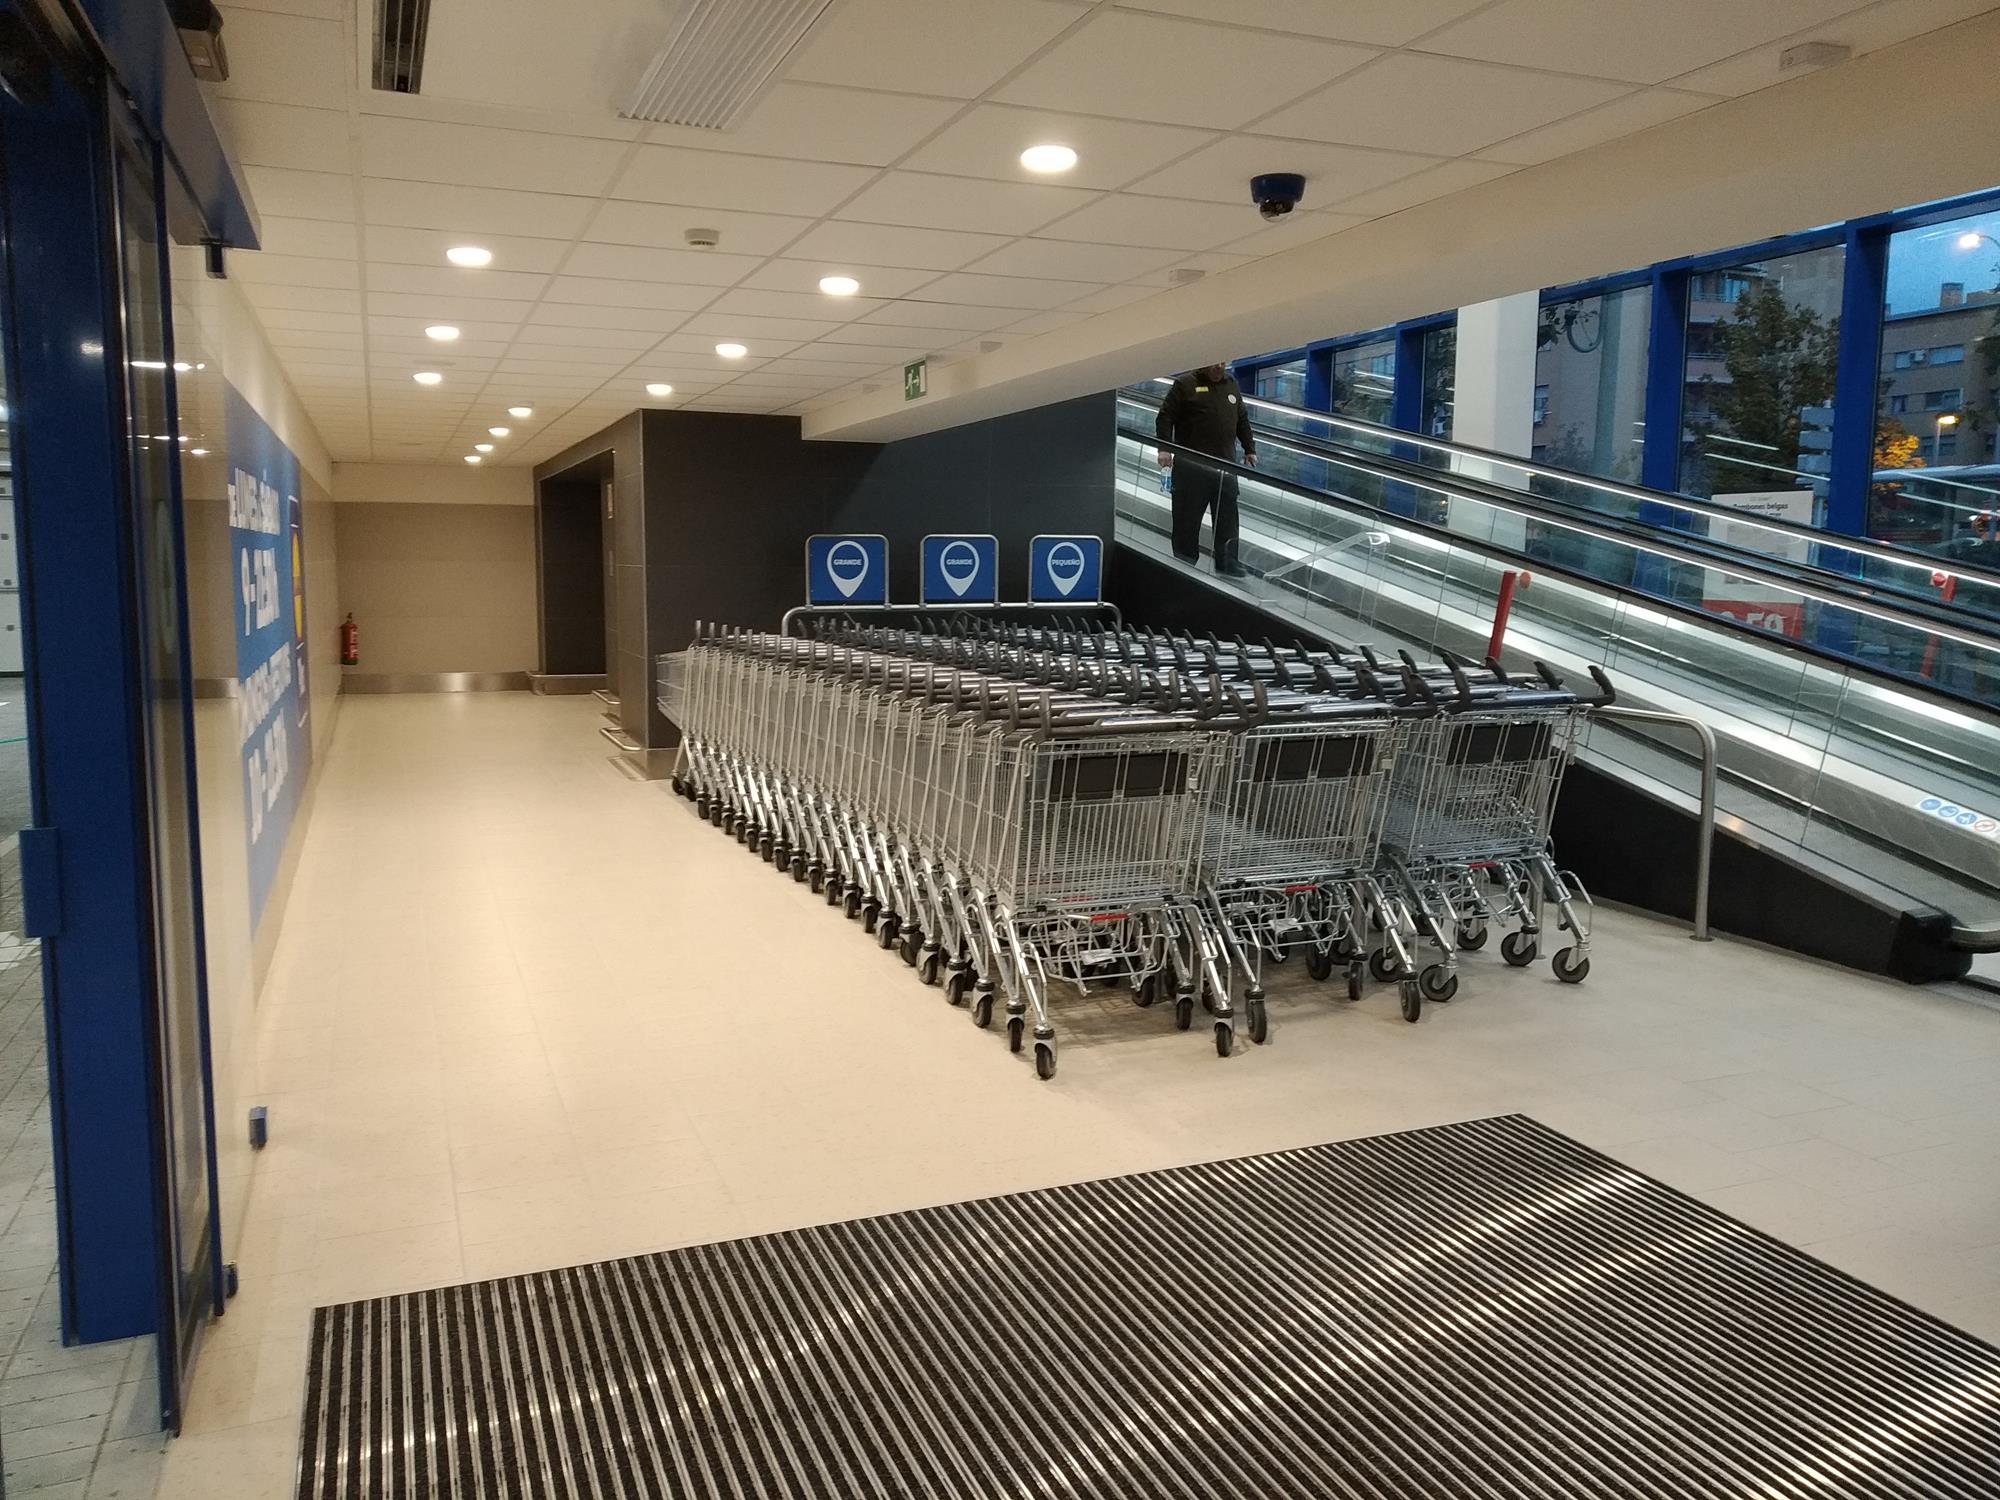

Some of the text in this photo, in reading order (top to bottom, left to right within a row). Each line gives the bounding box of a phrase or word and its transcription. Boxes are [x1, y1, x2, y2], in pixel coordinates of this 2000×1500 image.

[1767, 502, 1789, 511] belgas
[833, 558, 862, 566] GRANDE
[946, 558, 973, 566] GRANDE
[1051, 558, 1081, 567] PEQUEÑO
